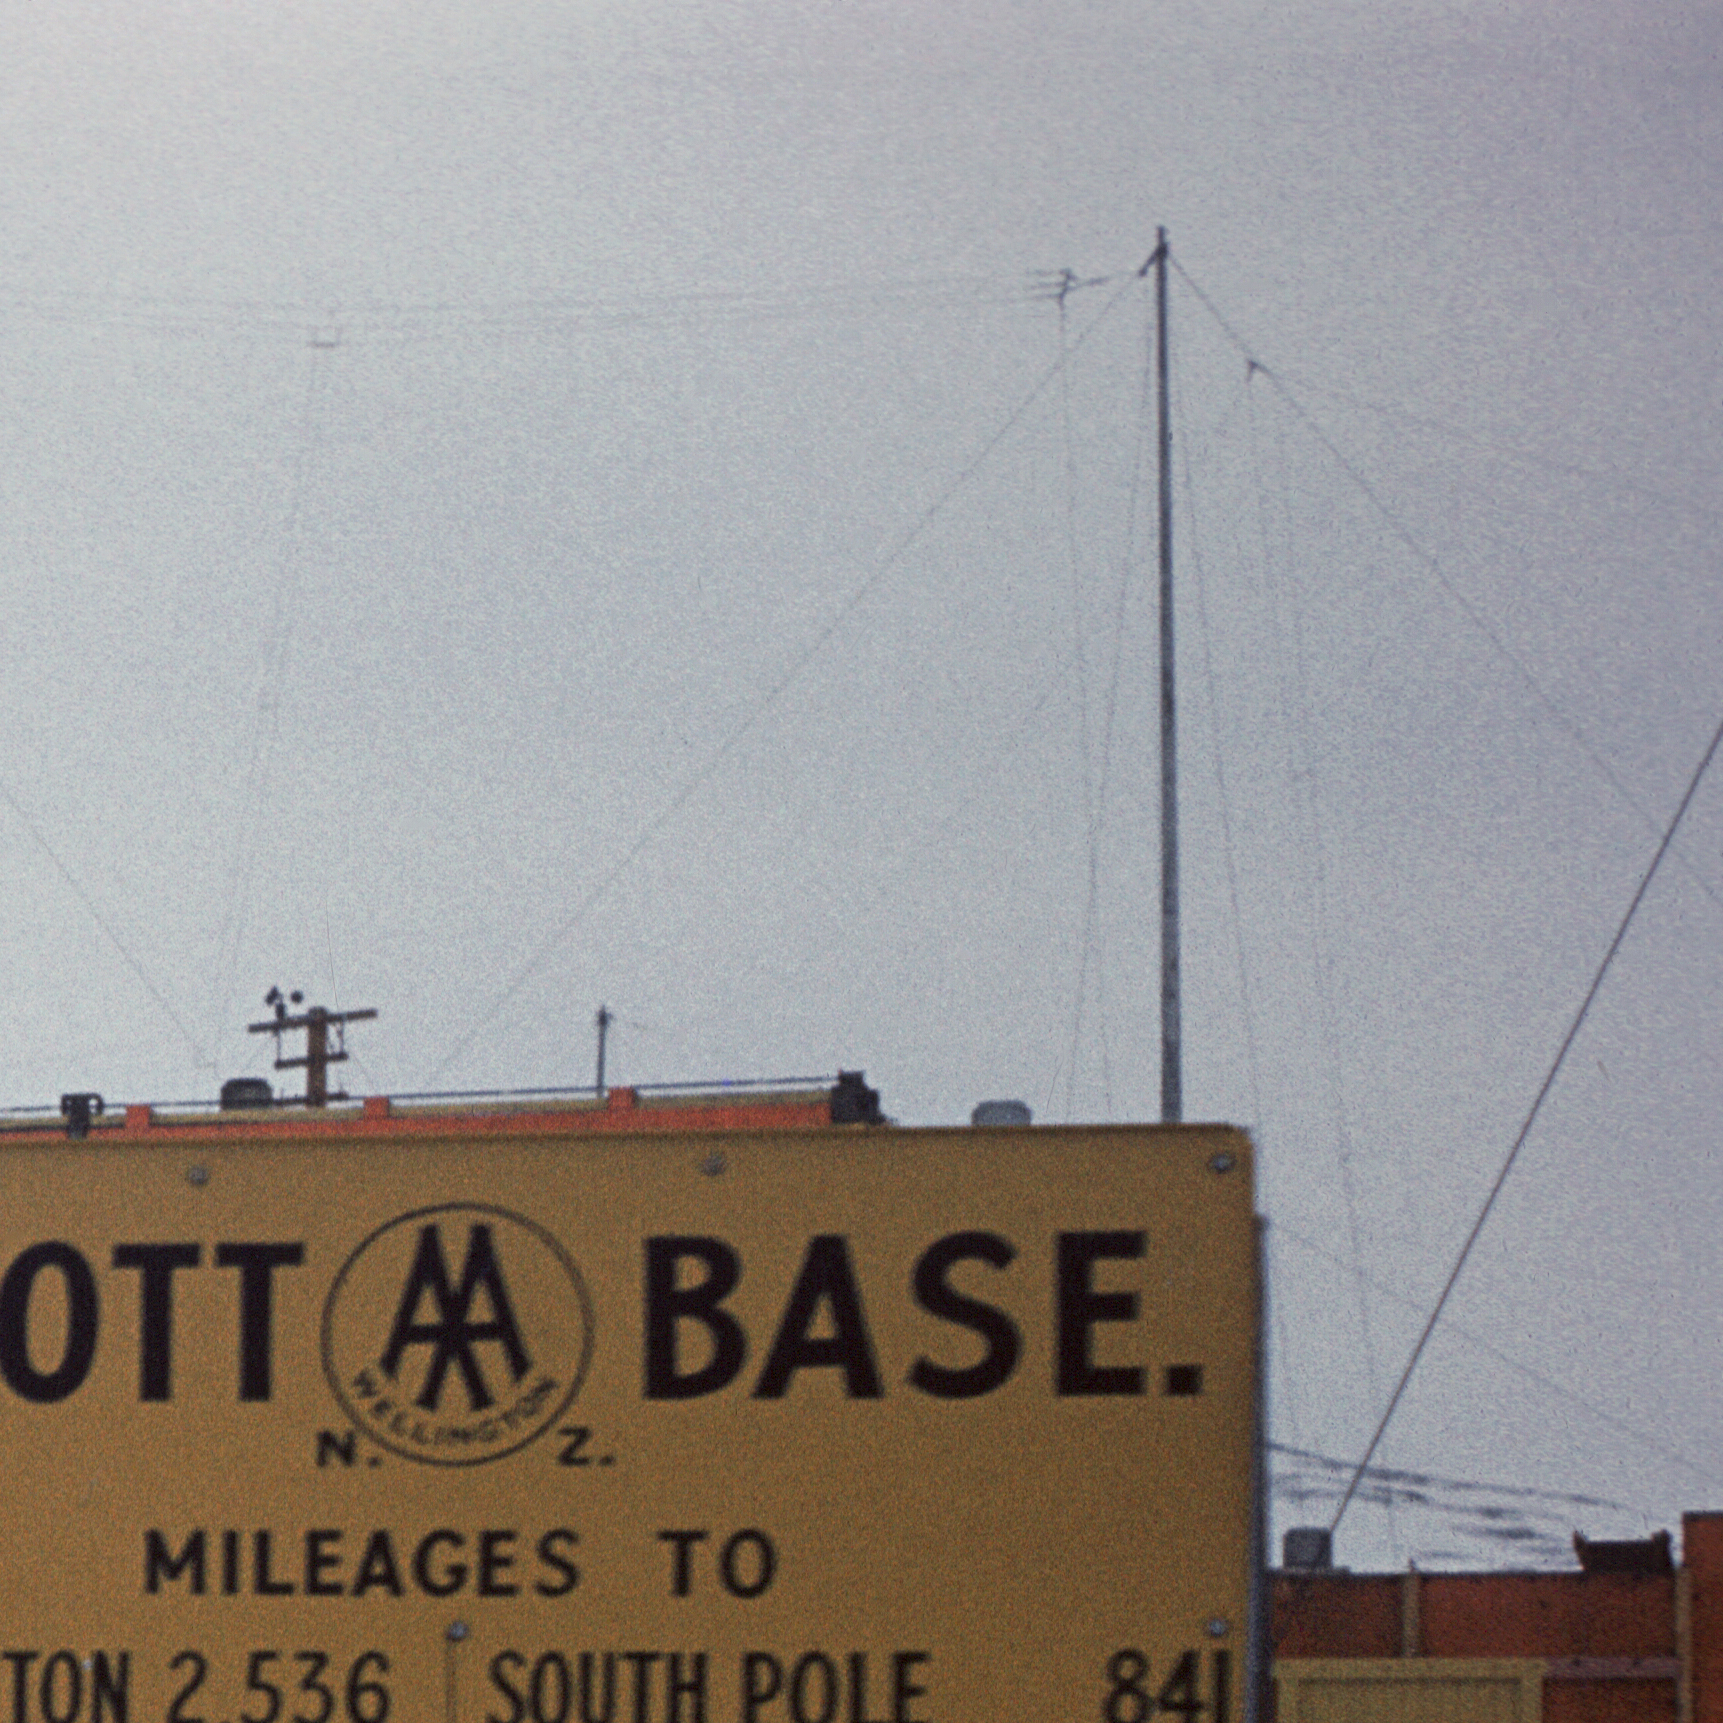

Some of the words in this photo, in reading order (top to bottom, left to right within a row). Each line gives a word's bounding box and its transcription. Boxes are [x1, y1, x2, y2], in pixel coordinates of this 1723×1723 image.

[643, 1229, 1204, 1401] BASE.
[145, 1527, 582, 1599] MILEAGES
[656, 1527, 779, 1600] TO
